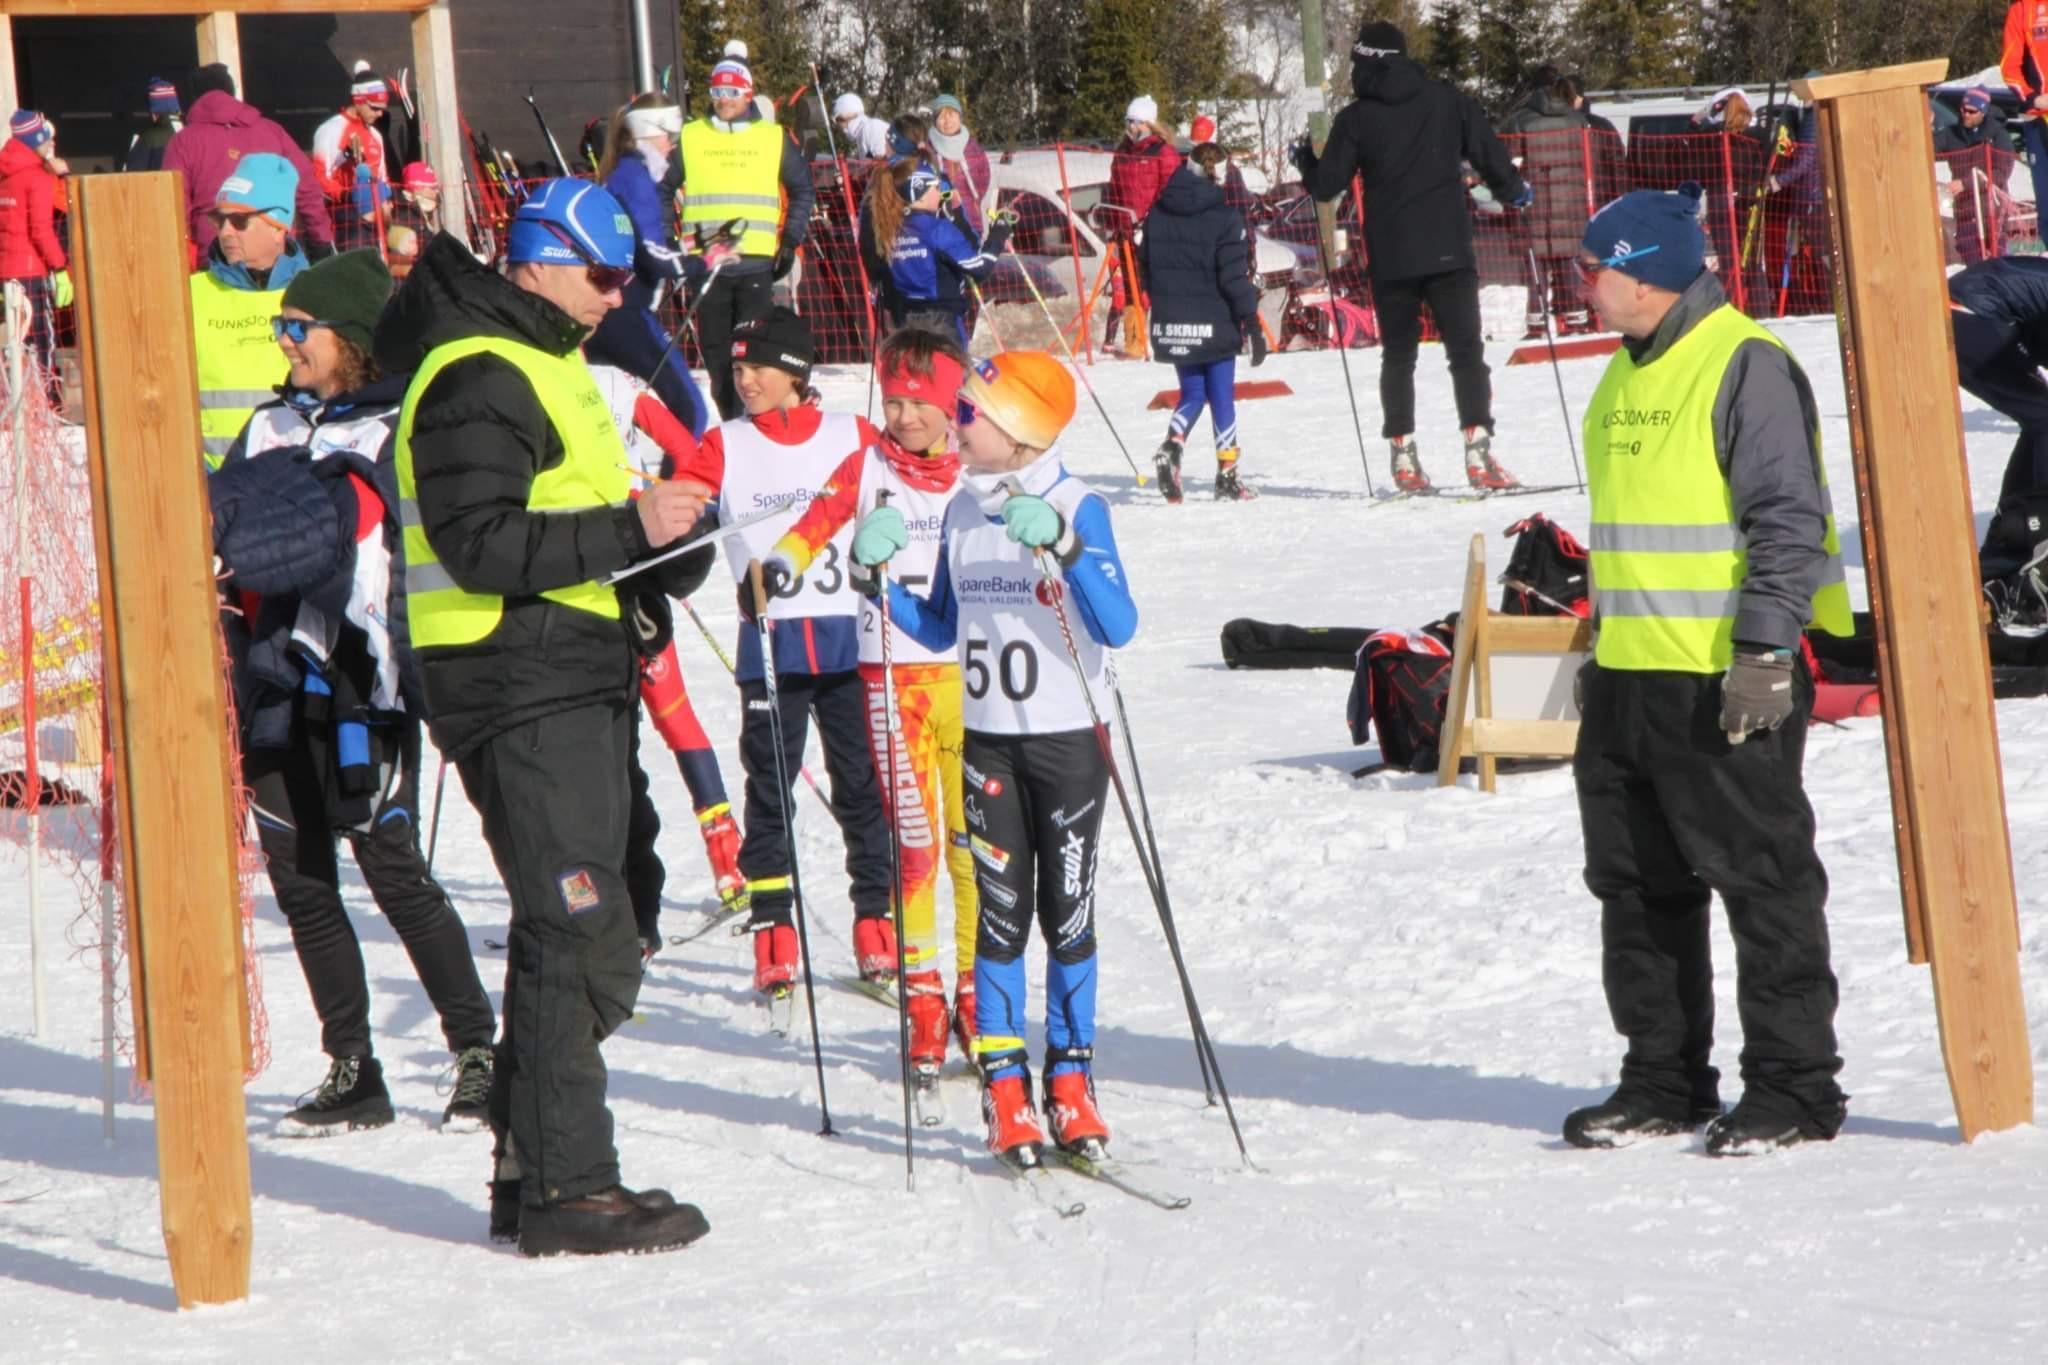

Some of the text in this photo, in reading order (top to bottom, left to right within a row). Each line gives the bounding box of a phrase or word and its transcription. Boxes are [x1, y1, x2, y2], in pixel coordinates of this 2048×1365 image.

[207, 314, 272, 329] FUNKSJO
[1165, 323, 1213, 337] SKRIM
[864, 610, 875, 633] 2
[965, 638, 1039, 702] 50
